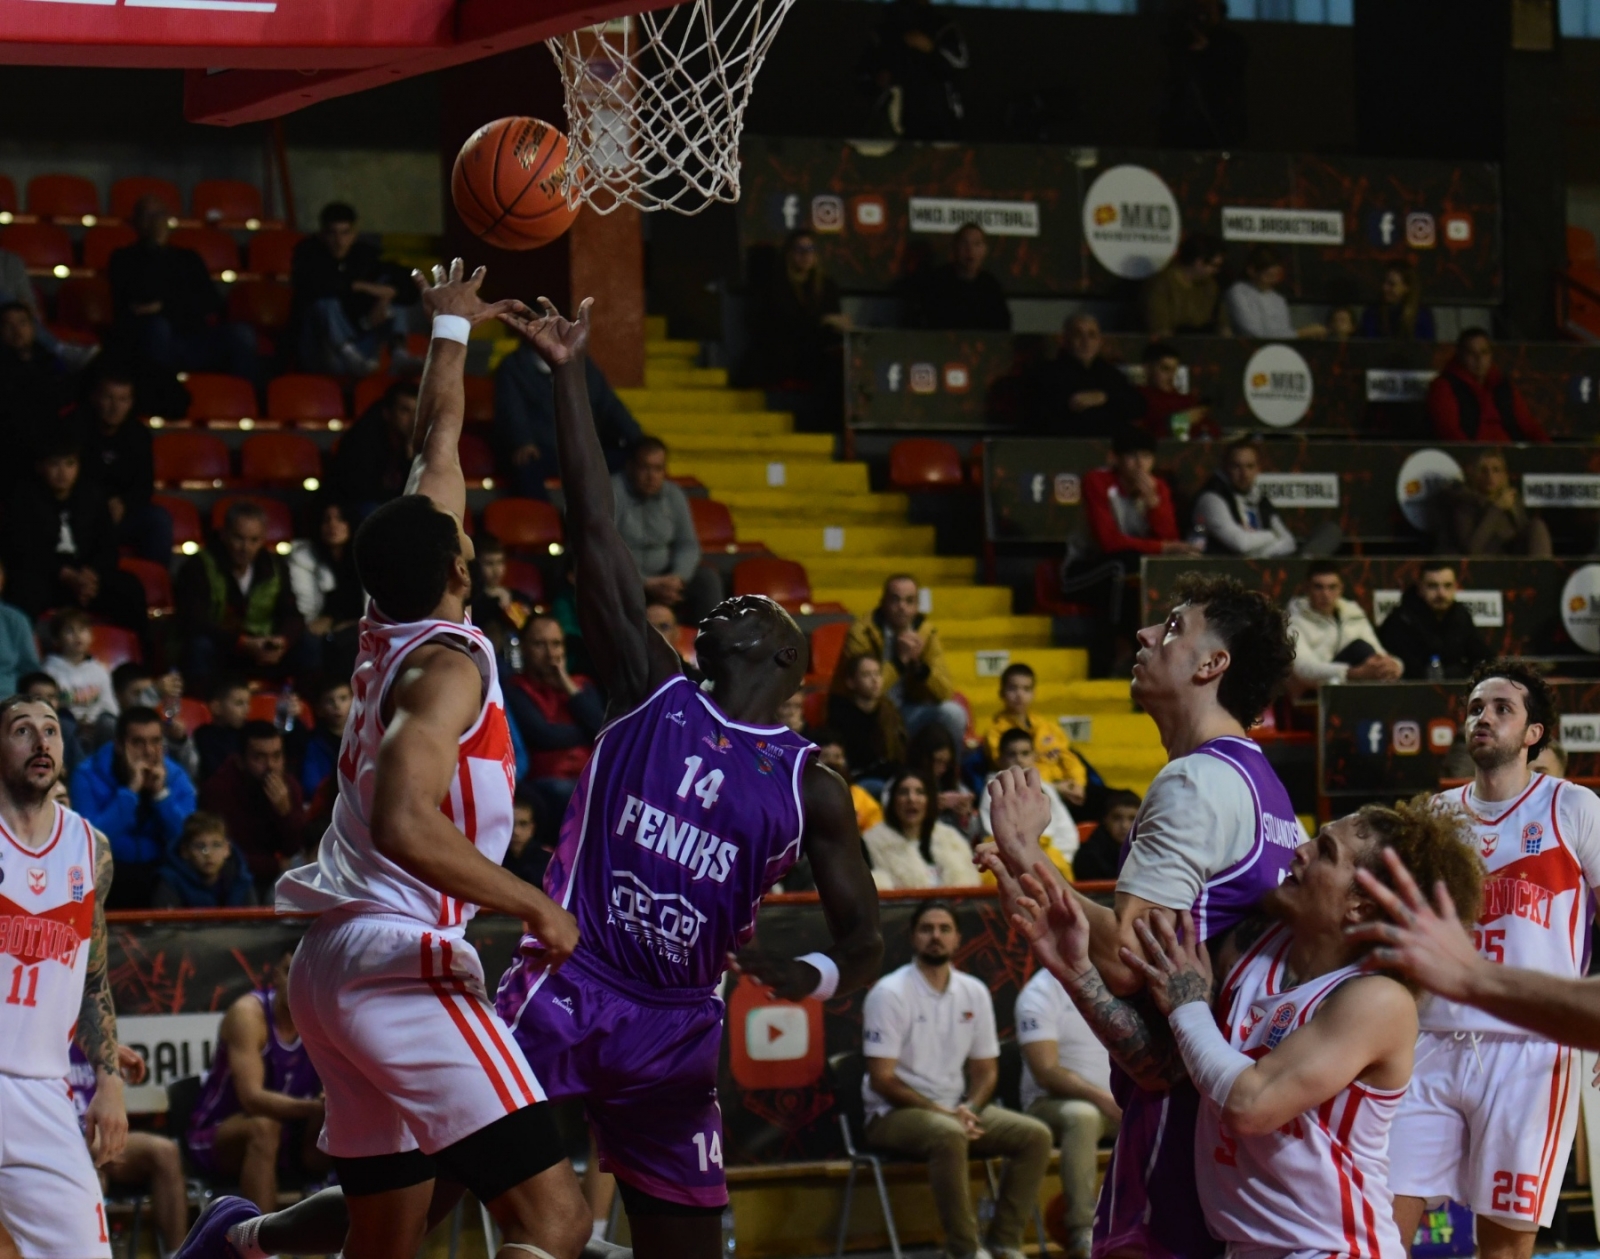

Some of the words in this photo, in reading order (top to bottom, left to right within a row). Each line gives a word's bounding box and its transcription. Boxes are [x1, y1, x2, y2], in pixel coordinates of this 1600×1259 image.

[1121, 203, 1171, 230] MKD
[676, 754, 725, 810] 14
[615, 794, 740, 883] FENIKS
[6, 964, 39, 1008] 11
[691, 1130, 723, 1172] 14
[1492, 1170, 1540, 1215] 25
